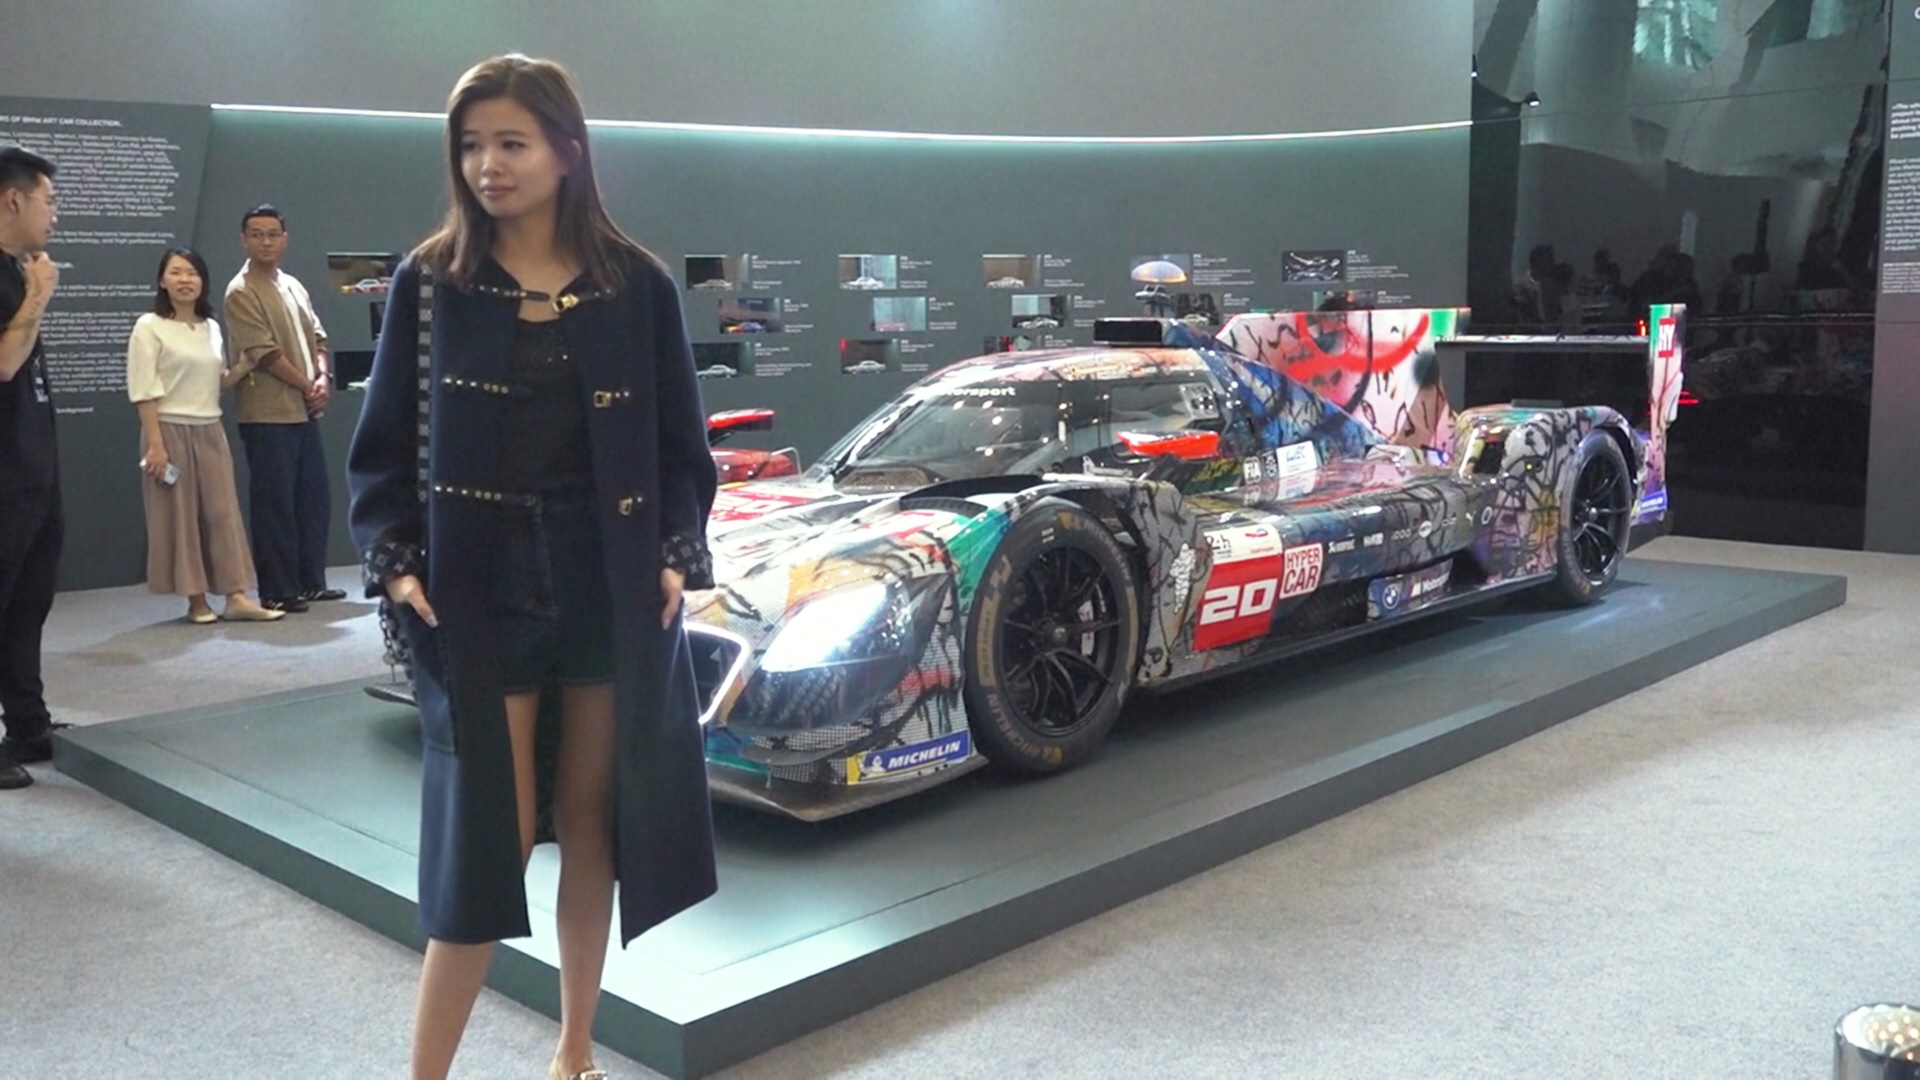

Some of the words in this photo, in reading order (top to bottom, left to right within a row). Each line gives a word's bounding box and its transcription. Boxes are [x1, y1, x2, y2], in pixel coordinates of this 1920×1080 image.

[1285, 547, 1320, 568] HYPER
[1283, 565, 1317, 595] CAR
[1200, 578, 1278, 625] 20
[887, 740, 961, 770] MICHELIN
